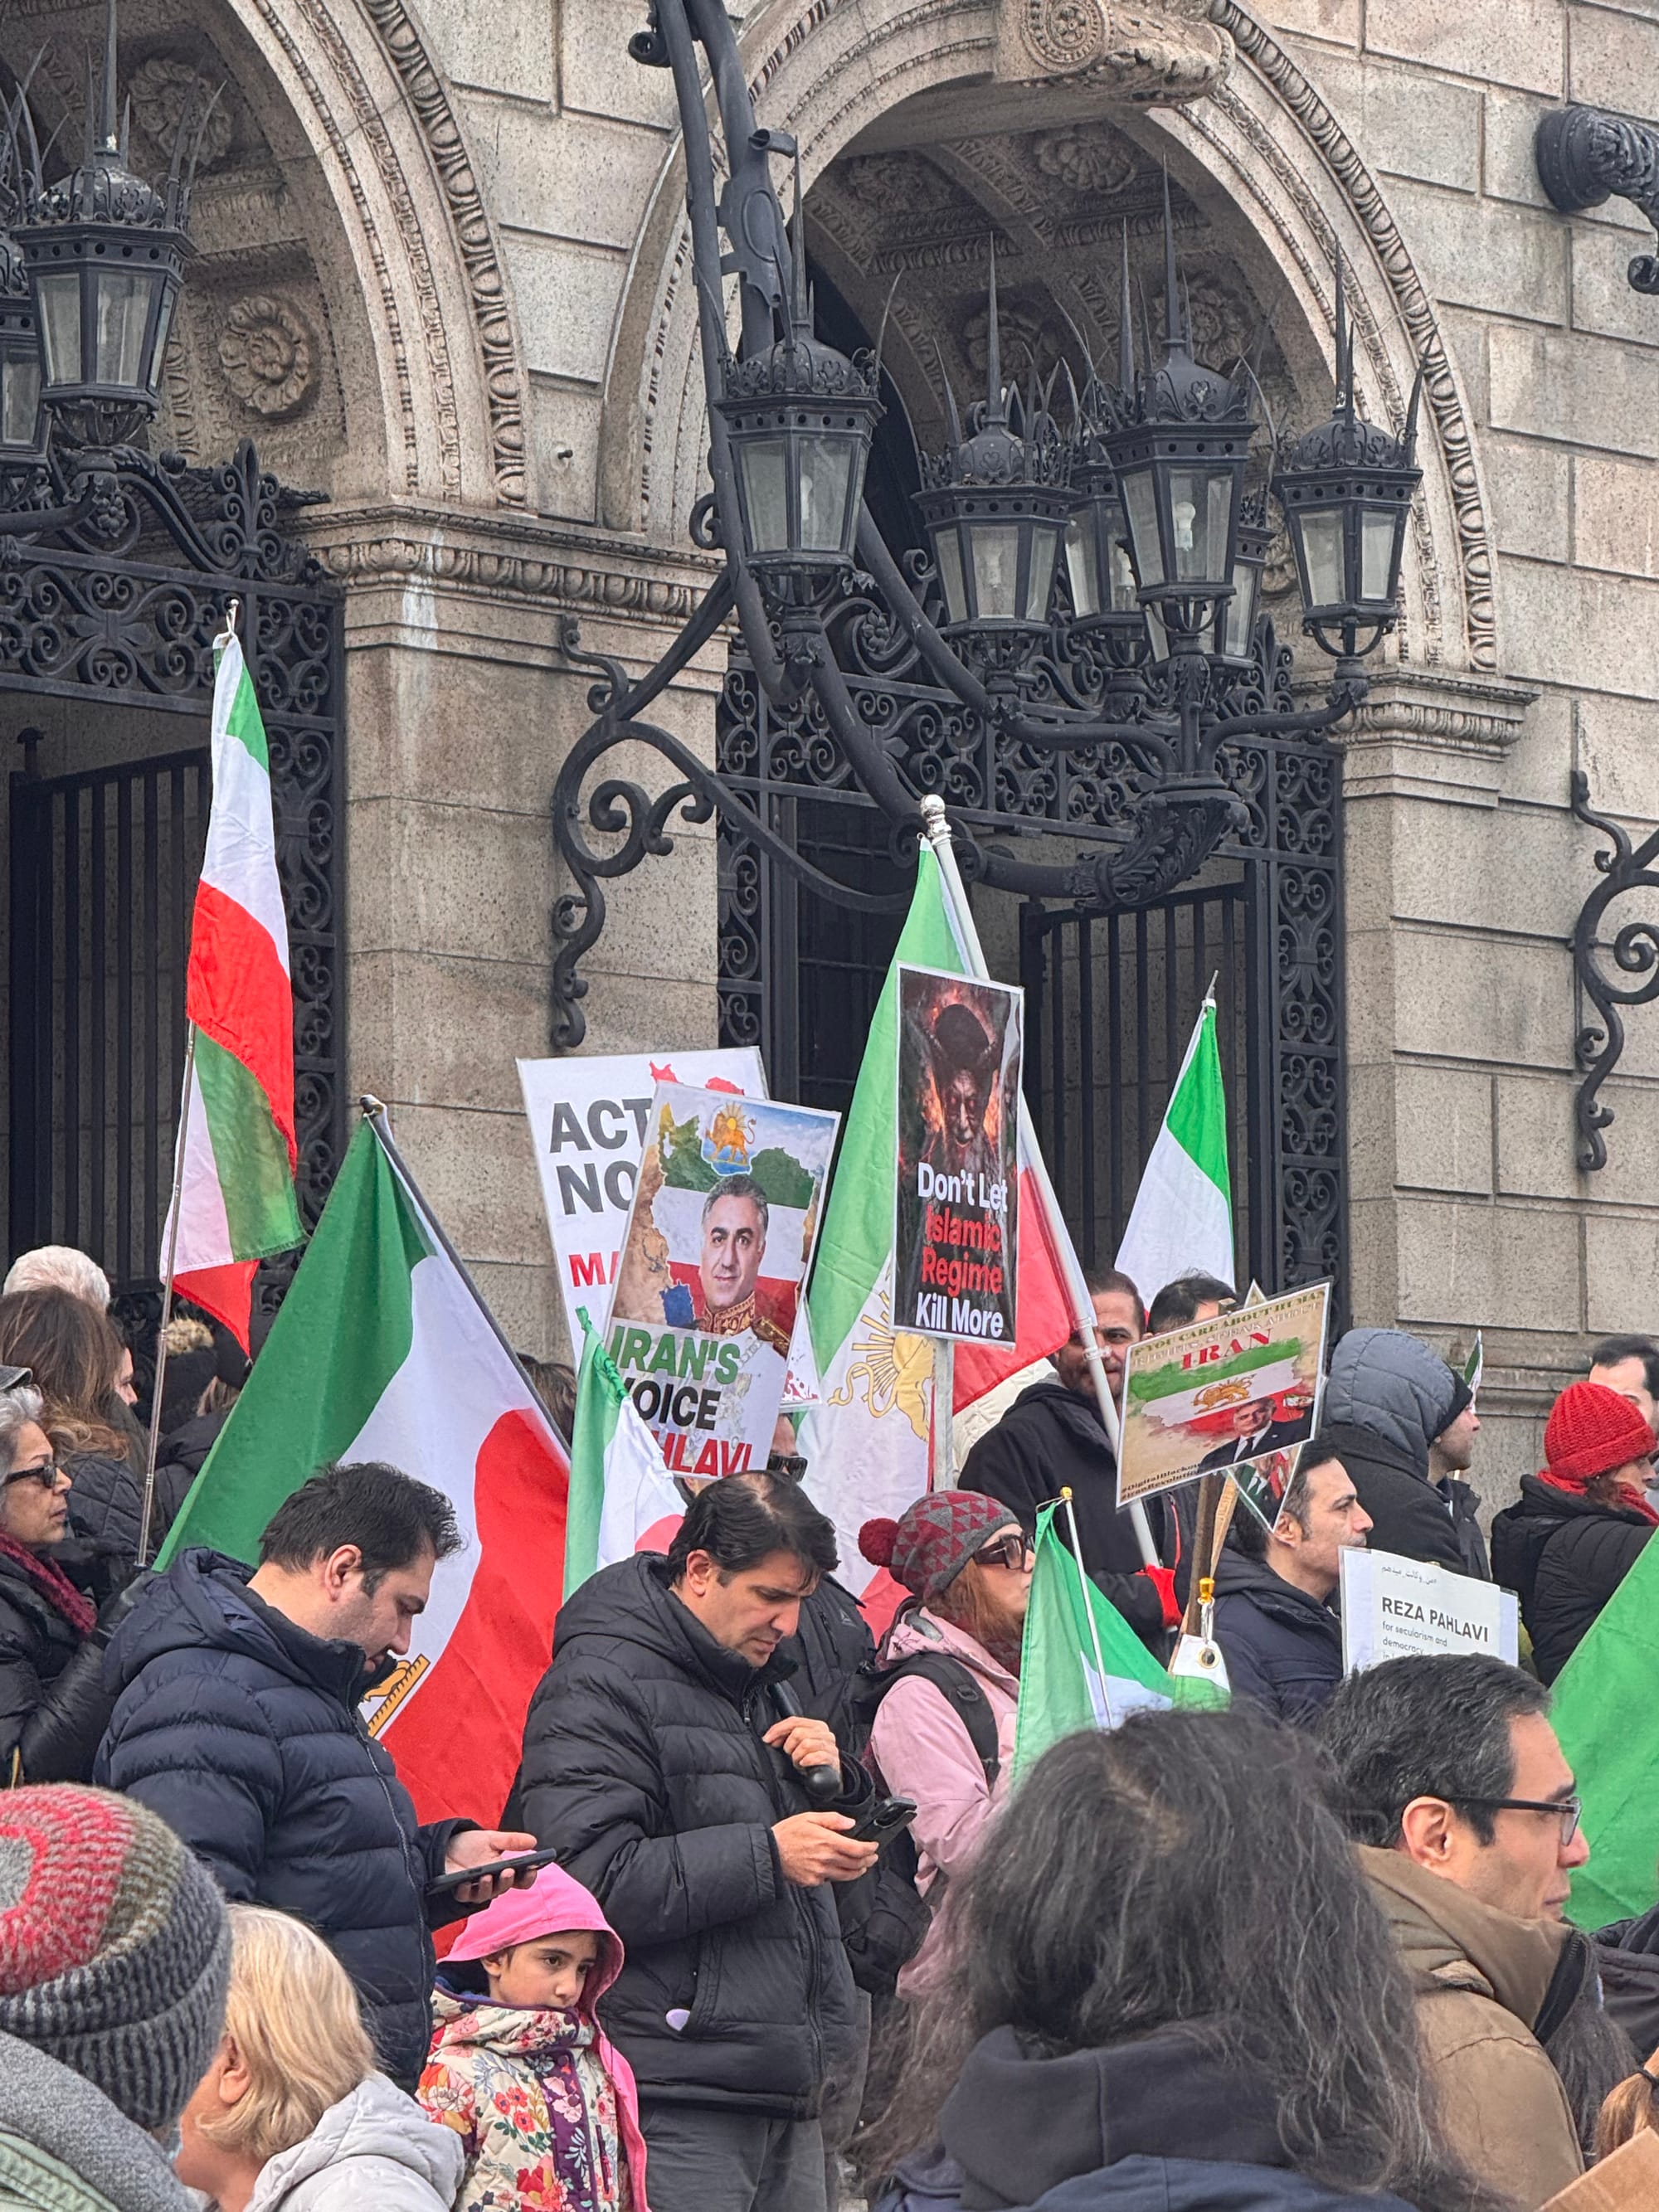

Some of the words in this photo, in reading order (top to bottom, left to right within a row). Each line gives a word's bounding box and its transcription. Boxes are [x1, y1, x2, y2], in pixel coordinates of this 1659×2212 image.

[550, 1097, 653, 1153] ACT
[917, 1161, 975, 1206] Don't
[979, 1172, 1008, 1213] Let
[926, 1204, 1001, 1252] Islamic
[922, 1247, 1003, 1297] Regime
[915, 1292, 947, 1330] Kill
[951, 1297, 1004, 1338] More
[1179, 1324, 1219, 1341] CARE
[1224, 1306, 1272, 1327] ABOUT
[610, 1325, 741, 1385] IRAN'S
[1182, 1328, 1273, 1370] IRAN
[1381, 1597, 1425, 1622] REZA
[1429, 1608, 1488, 1642] PAHLAVI
[1383, 1621, 1394, 1631] for
[1395, 1626, 1434, 1641] secularism
[1435, 1637, 1447, 1646] and
